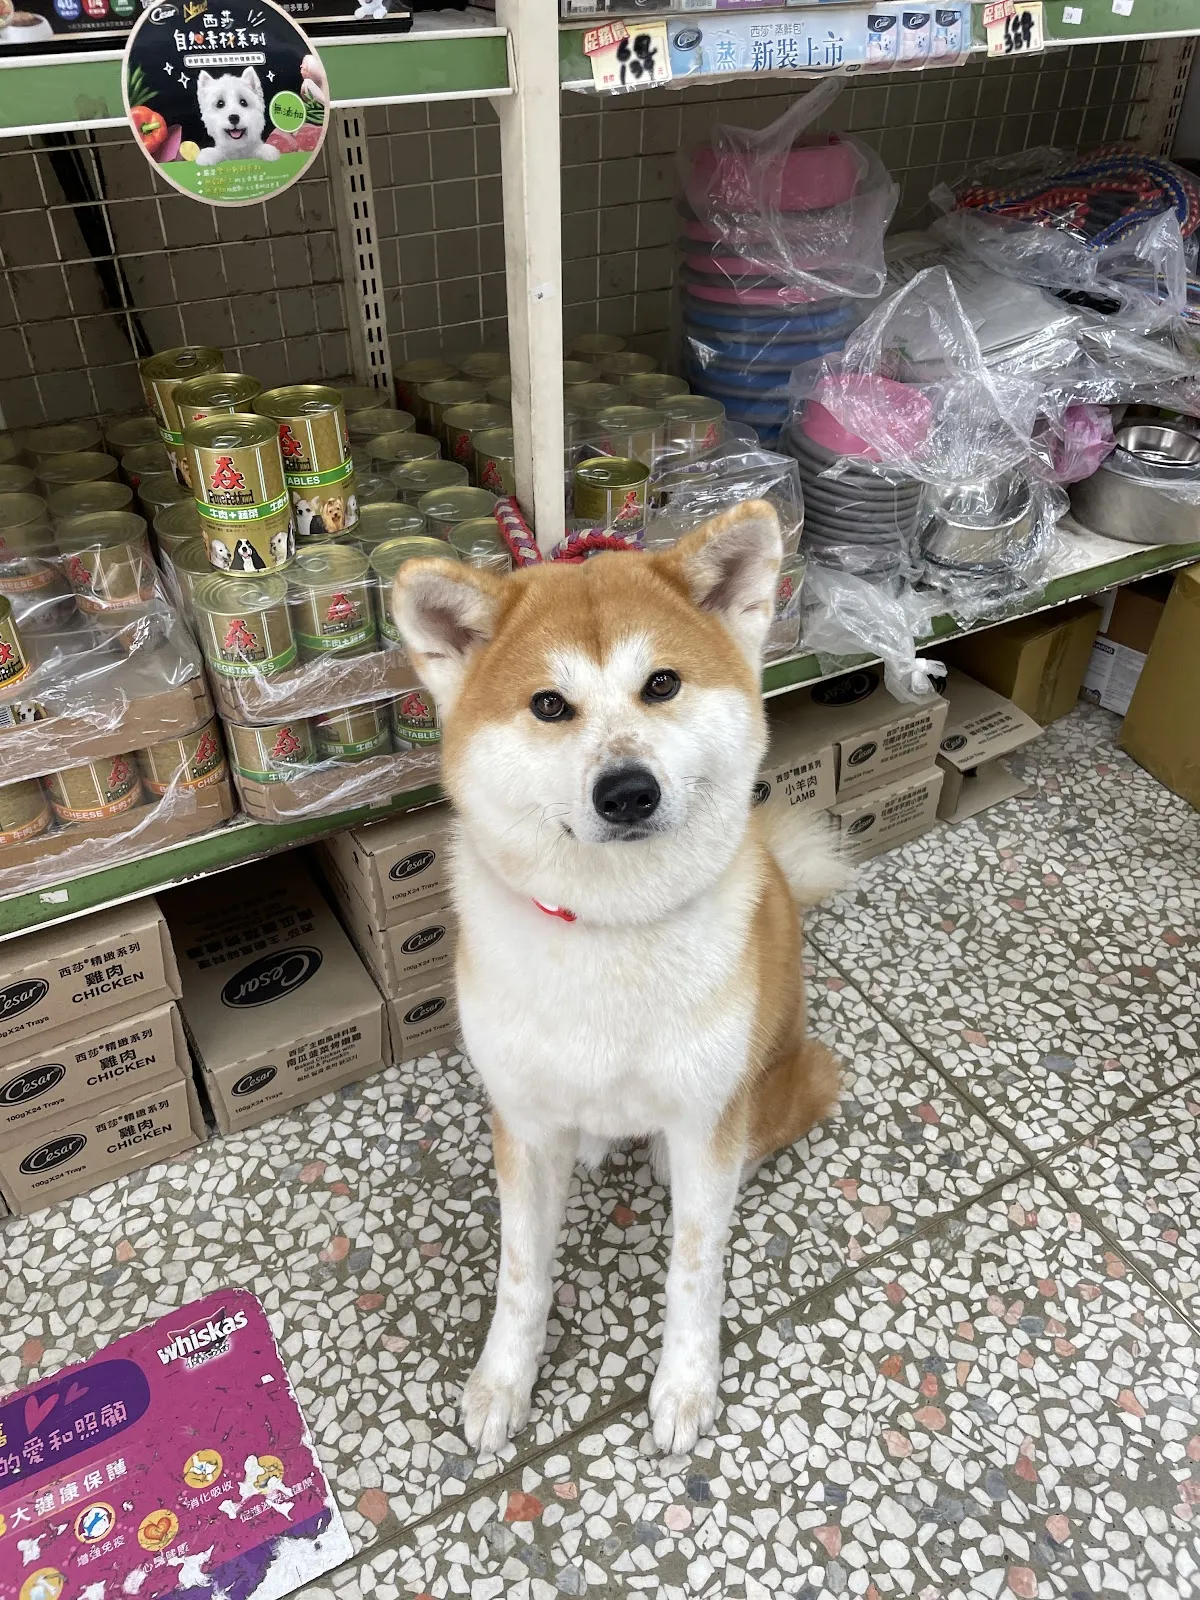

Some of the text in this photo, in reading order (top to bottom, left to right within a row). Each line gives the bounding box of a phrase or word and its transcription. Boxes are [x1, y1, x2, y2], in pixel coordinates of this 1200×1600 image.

[150, 8, 177, 22] Cesar
[203, 10, 234, 28] 西莎
[173, 28, 267, 52] 自然素材系列
[751, 31, 844, 72] 新裝上市
[716, 41, 737, 70] 蒸
[785, 775, 818, 796] 小羊肉
[790, 789, 816, 806] LAMB
[62, 810, 104, 820] CHEESE
[396, 853, 430, 873] Cesar
[407, 929, 441, 948] Cesar
[71, 971, 146, 1004] CHICKEN
[84, 963, 125, 988] 雞肉
[233, 953, 311, 1000] Cesar
[409, 1000, 441, 1020] Cesar
[86, 1055, 157, 1087] CHICKEN
[99, 1048, 138, 1071] 雞肉
[5, 1069, 57, 1101] Cesar
[237, 1068, 273, 1093] Cesar
[5, 1098, 66, 1123] 100gX24 Trays
[106, 1123, 173, 1155] CHICKEN
[118, 1119, 155, 1140] 雞肉
[29, 1139, 81, 1170] Cesar
[30, 1165, 87, 1190] 100gX24 Trays
[157, 1310, 249, 1365] whiskas
[77, 1534, 126, 1567] 增強免疫
